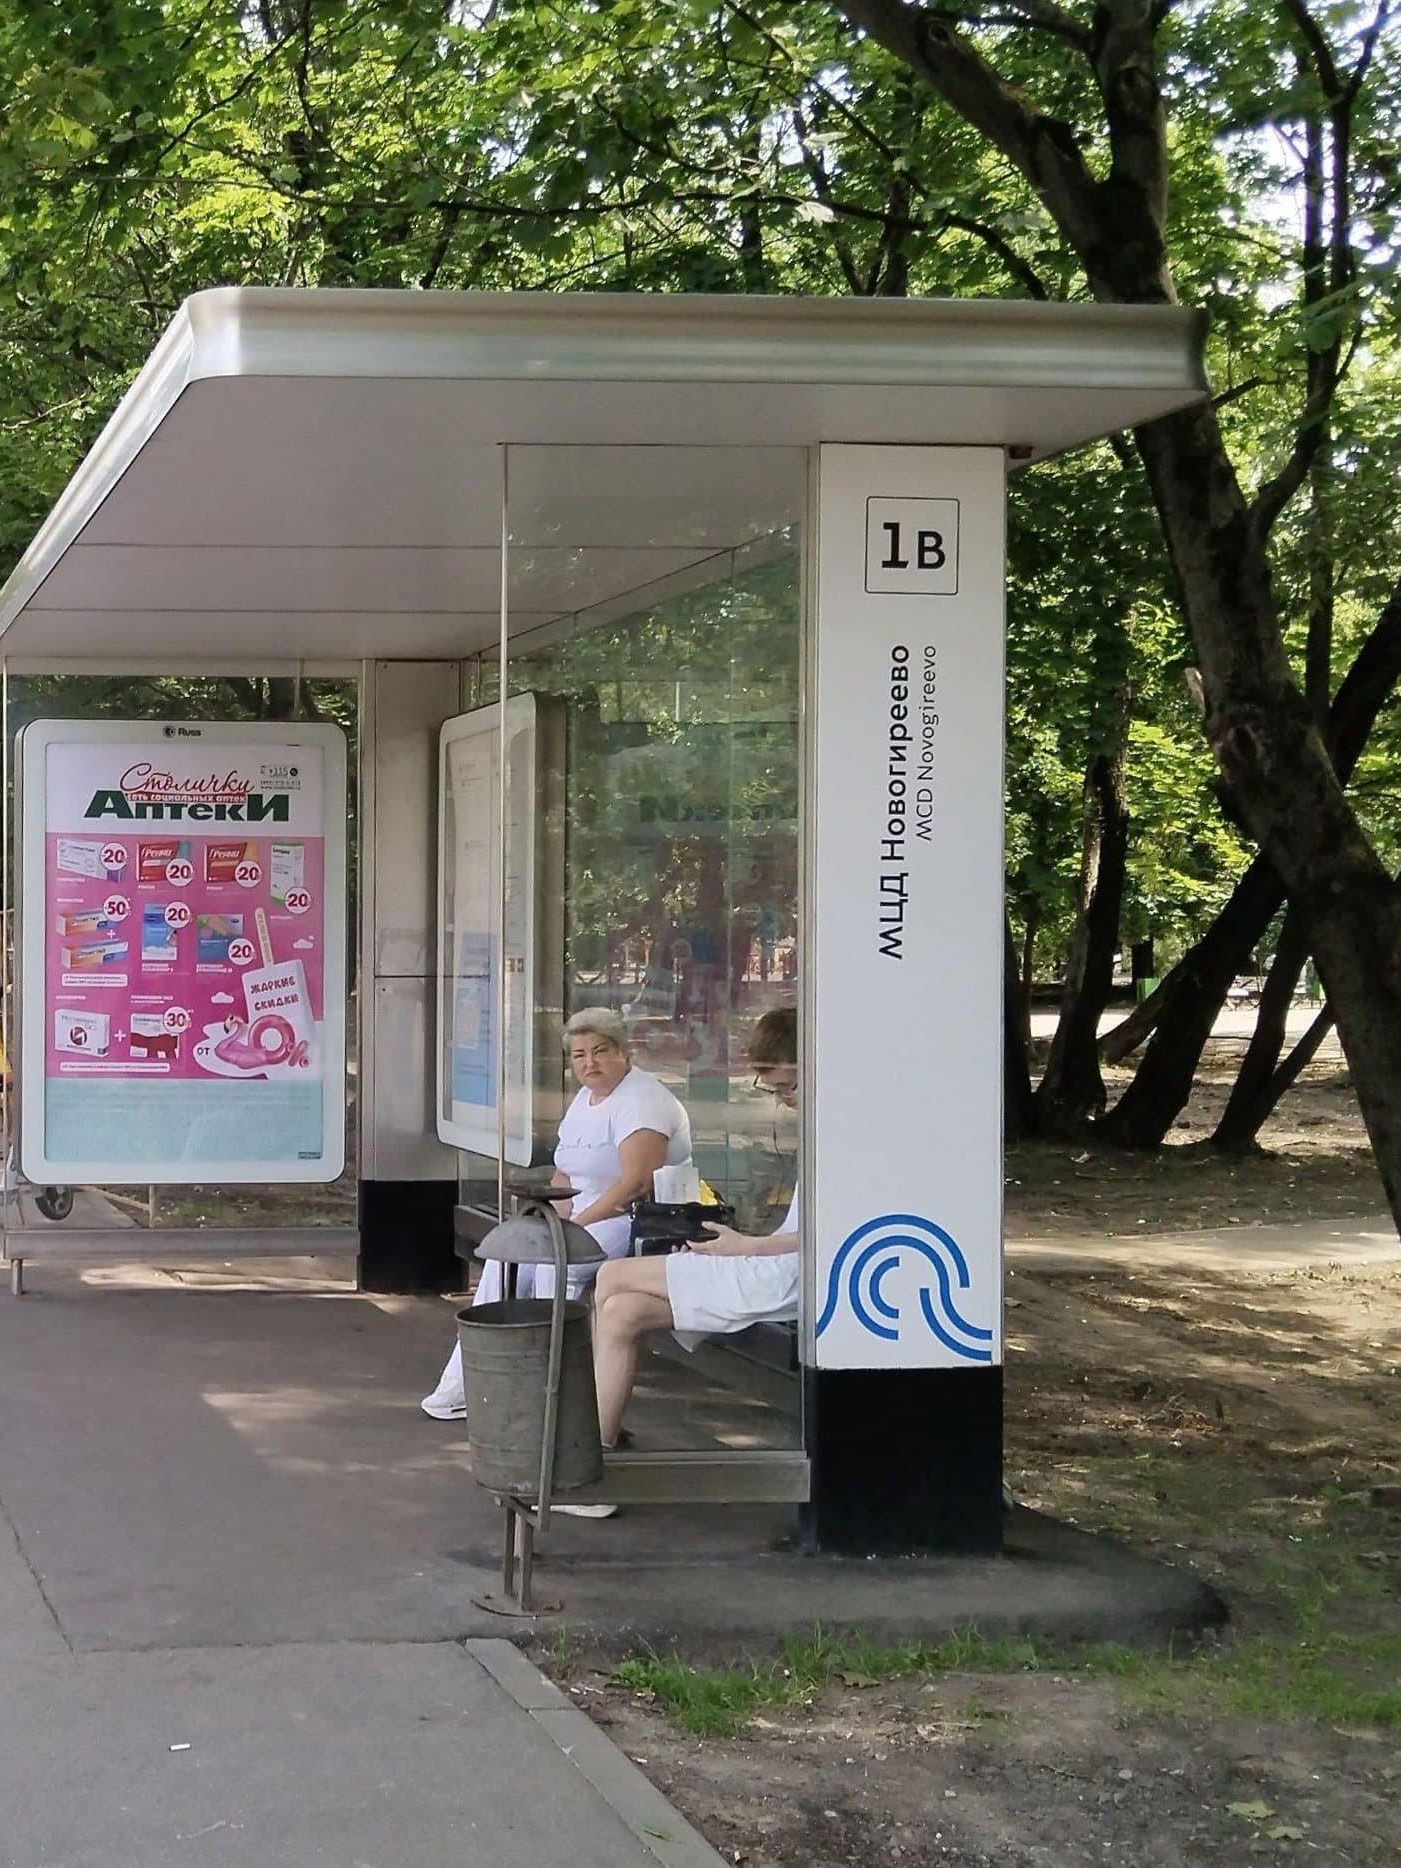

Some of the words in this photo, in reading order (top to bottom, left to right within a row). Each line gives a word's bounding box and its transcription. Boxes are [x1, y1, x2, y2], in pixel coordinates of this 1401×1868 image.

[916, 645, 940, 781] Novogireevo
[880, 644, 914, 862] Новогиреево
[120, 762, 255, 793] Столички
[150, 793, 215, 803] социальных
[915, 787, 934, 842] MCD
[878, 872, 909, 960] МЦД
[250, 975, 296, 994] ЖАРКИЕ
[254, 994, 299, 1011] СКИДКИ
